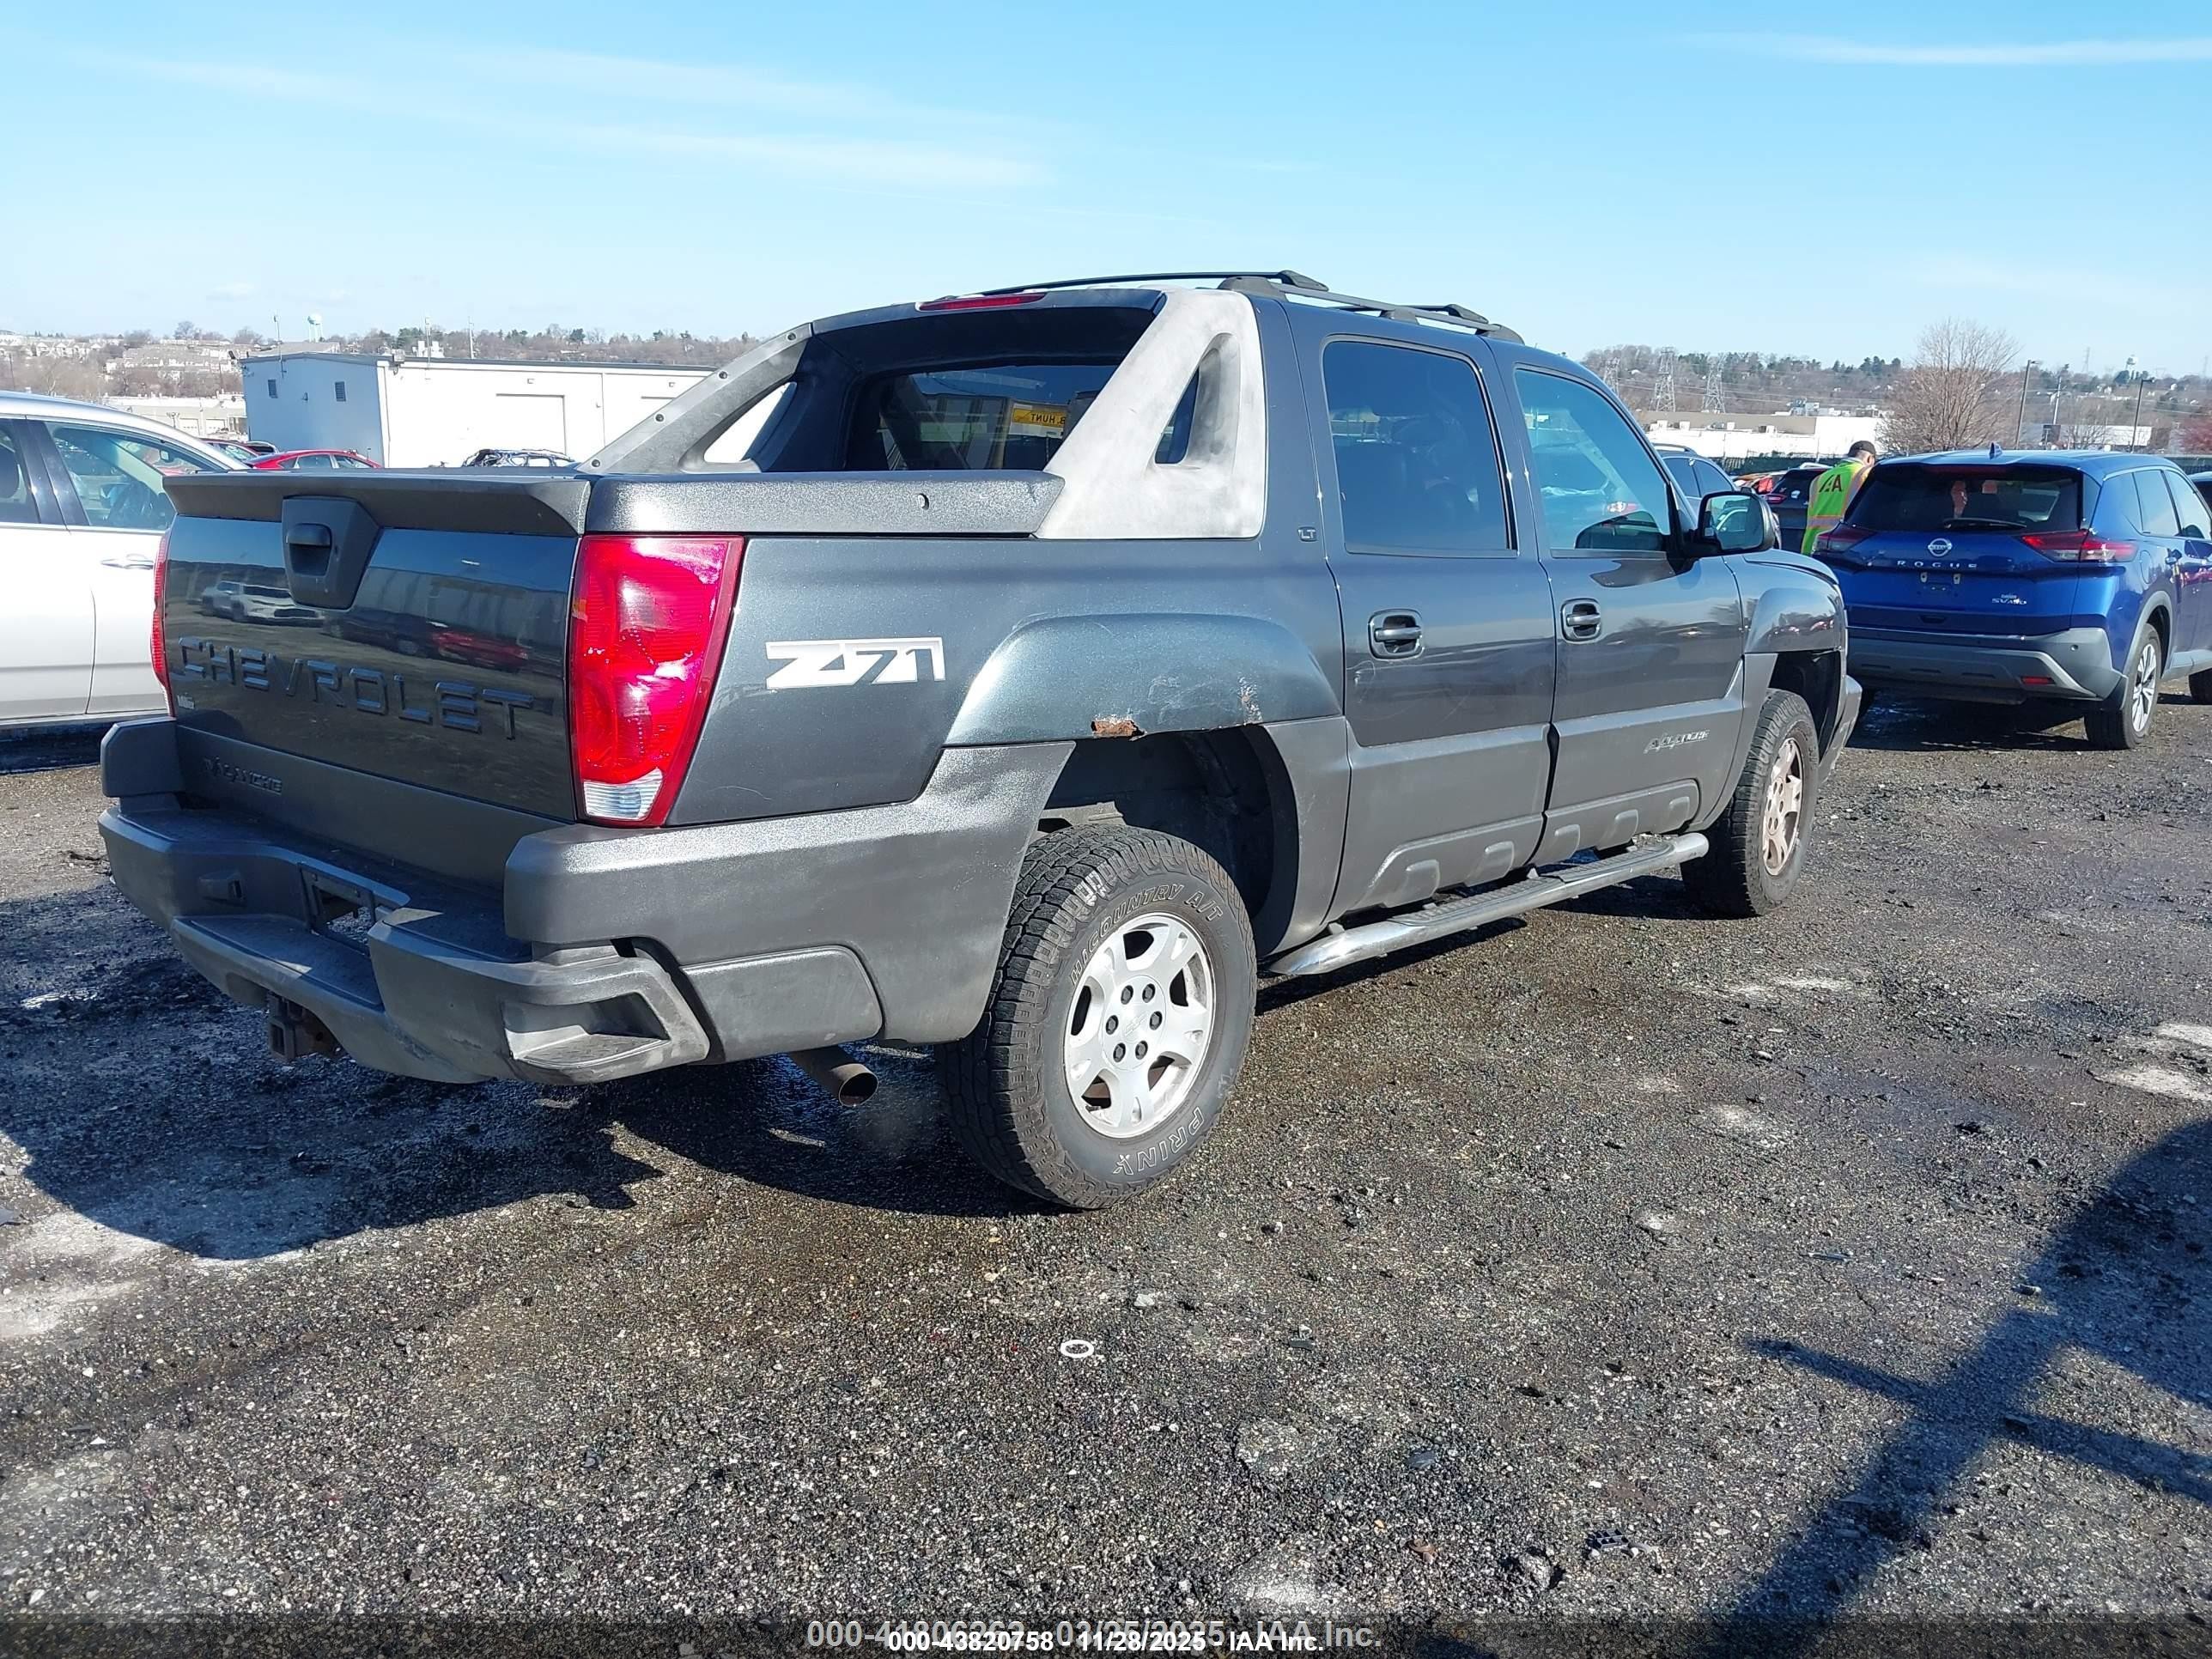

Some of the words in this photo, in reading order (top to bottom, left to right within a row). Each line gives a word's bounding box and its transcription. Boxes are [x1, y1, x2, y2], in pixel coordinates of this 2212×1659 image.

[1897, 560, 1978, 569] ROGUE
[178, 635, 534, 740] CHEVROLET
[765, 636, 946, 690] Z71
[1112, 1105, 1205, 1177] PRINX
